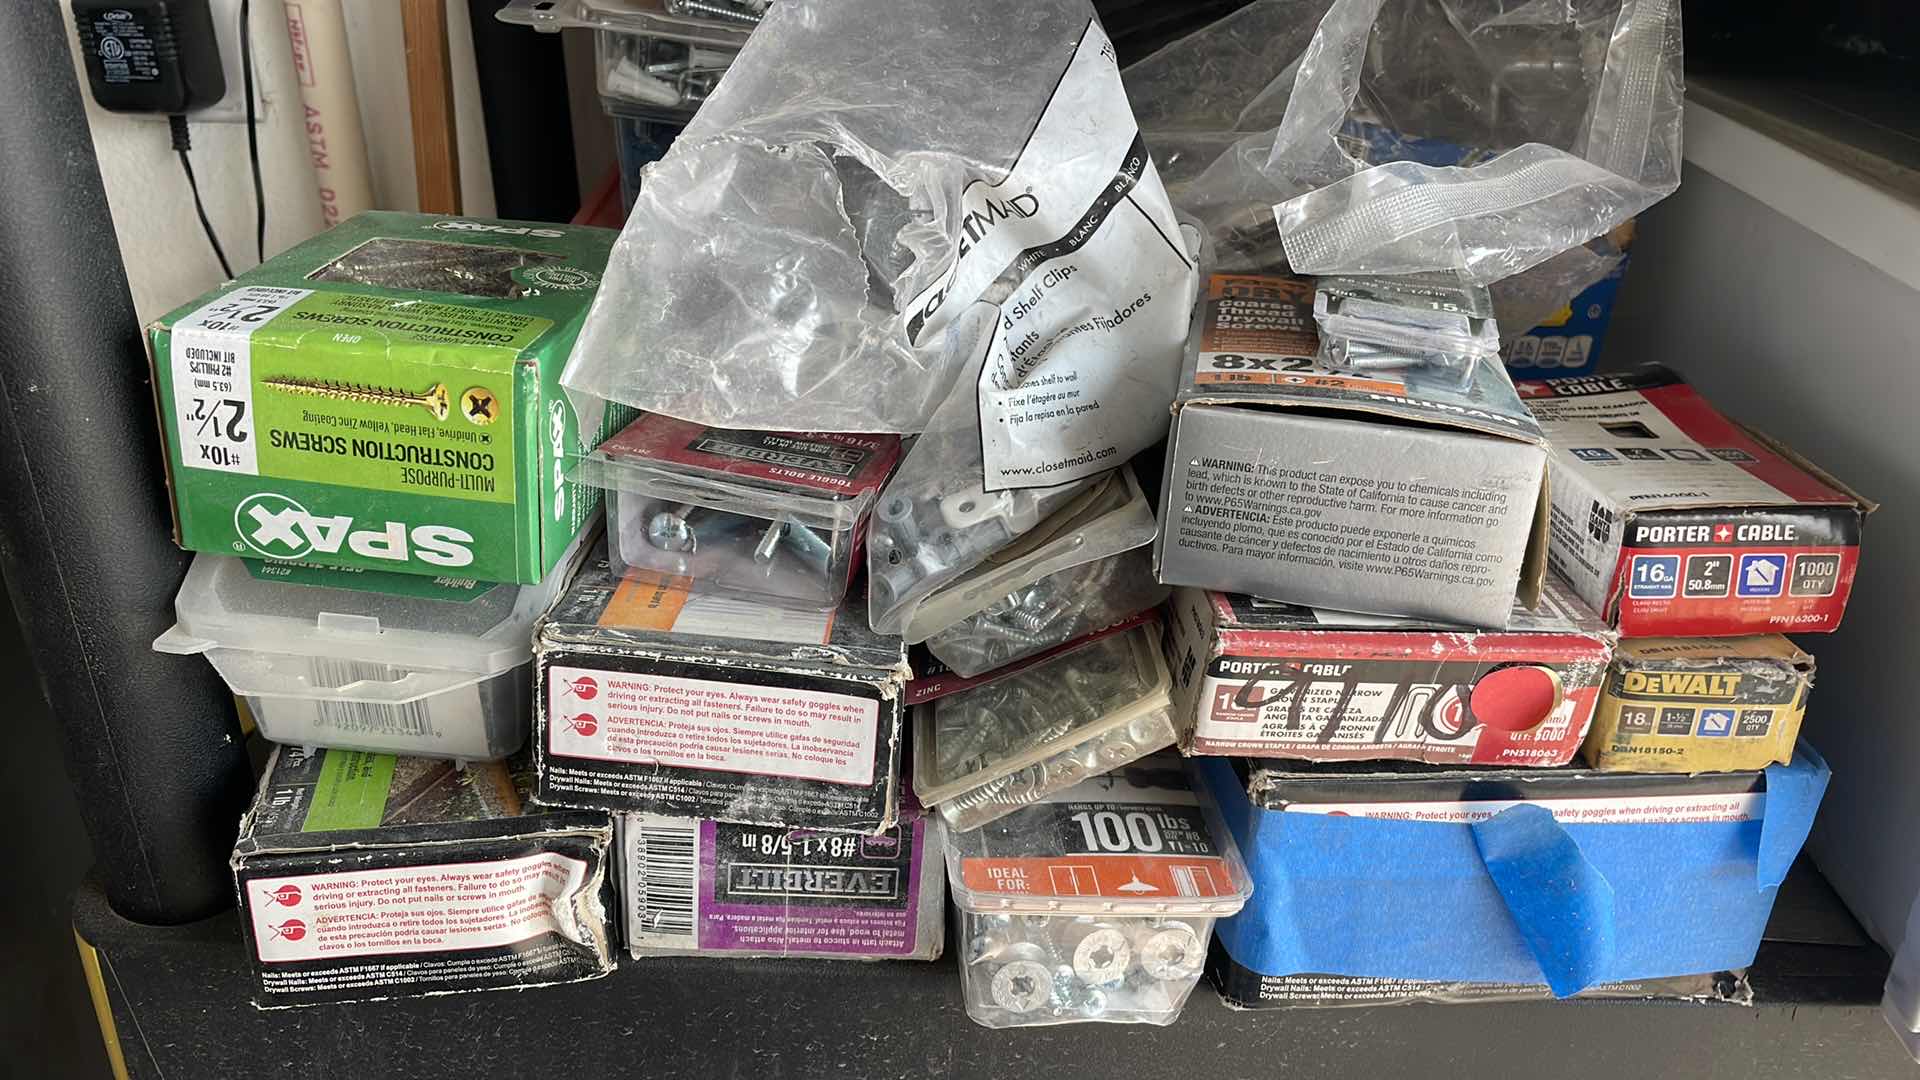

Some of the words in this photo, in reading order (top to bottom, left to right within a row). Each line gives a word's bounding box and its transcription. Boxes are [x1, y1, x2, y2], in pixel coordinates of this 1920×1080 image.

[304, 104, 330, 170] ASTM
[1018, 250, 1046, 272] WHITE
[1069, 216, 1098, 246] BLANC
[1114, 157, 1140, 193] BLANCO
[432, 222, 566, 238] SPAX
[1013, 284, 1043, 319] Shelf
[1043, 264, 1077, 288] Clips
[1093, 292, 1151, 332] Fijadores
[1217, 307, 1295, 317] Thread
[1219, 300, 1296, 309] Coarse
[1431, 303, 1457, 312] 15
[292, 311, 363, 327] SCREWS
[1217, 315, 1303, 325] Drywall
[368, 318, 514, 343] CONSTRUCTION
[1216, 323, 1300, 331] Screws
[332, 333, 361, 344] OPEN
[185, 346, 220, 361] INCLUDED
[222, 351, 234, 362] BIT
[189, 360, 220, 374] PHILLIPS
[221, 364, 230, 375] #2
[193, 378, 209, 389] mm)
[210, 379, 231, 391] (63.5
[1557, 379, 1627, 395] CABLE
[302, 410, 335, 425] Coating
[1025, 412, 1033, 421] la
[1035, 411, 1054, 423] repisa
[1066, 407, 1074, 415] la
[1076, 400, 1099, 414] pared
[338, 416, 357, 428] Zinc
[359, 418, 388, 431] Yellow
[391, 422, 414, 435] Head,
[416, 424, 435, 437] Flat
[437, 427, 476, 441] Unidrive,
[269, 428, 346, 454] SCREWS
[199, 444, 239, 466] #10x
[351, 438, 494, 470] CONSTRUCTION
[1000, 446, 1117, 476] www.closetmaid.com
[551, 403, 565, 521] SPAX
[400, 466, 495, 492] MULTI-PURPOSE
[768, 467, 805, 479] BOLTS
[809, 472, 852, 487] TOGGLE
[1202, 458, 1254, 472] WARNING:
[1257, 465, 1277, 475] This
[1279, 468, 1316, 481] product
[1319, 473, 1336, 482] can
[1339, 476, 1374, 489] expose
[1376, 480, 1394, 491] you
[1409, 483, 1459, 497] chemicals
[1461, 489, 1506, 504] including
[1187, 468, 1209, 480] lead,
[1213, 471, 1241, 483] which
[1254, 476, 1286, 489] known
[1301, 481, 1316, 492] the
[1318, 483, 1344, 496] State
[1359, 488, 1405, 503] California
[1419, 498, 1449, 509] cause
[1452, 501, 1486, 513] cancer
[1488, 504, 1507, 515] and
[1194, 504, 1270, 523] ADVERTENCIA:
[1196, 493, 1322, 519] www.P65Warnings.ca.gov
[243, 500, 475, 567] SPAX
[1636, 526, 1710, 542] PORTER
[1737, 525, 1795, 541] CABLE
[1800, 562, 1833, 577] 1000
[1689, 580, 1725, 590] 50.8mm
[1803, 580, 1824, 589] QTY
[1770, 614, 1828, 623] PFN16200-1
[1220, 662, 1280, 674] PORT
[607, 680, 651, 692] WARNING:
[654, 685, 683, 694] Protect
[685, 688, 703, 697] your
[706, 691, 726, 699] eyes.
[729, 692, 758, 703] Always
[760, 696, 779, 704] wear
[781, 697, 806, 707] safety
[808, 701, 840, 712] goggles
[843, 705, 864, 714] when
[916, 683, 940, 696] ZINC
[1625, 712, 1645, 725] 18
[1743, 715, 1768, 724] 2500
[549, 782, 572, 792] Drywall
[574, 784, 599, 793] Screws:
[1416, 810, 1449, 820] Protect
[1451, 811, 1469, 821] your
[1554, 809, 1580, 819] safety
[1582, 808, 1616, 818] goggles
[1619, 806, 1641, 815] when
[1643, 804, 1673, 815] driving
[1686, 803, 1726, 813] extracting
[1728, 802, 1740, 810] all
[1072, 812, 1162, 852] 100
[1157, 814, 1190, 829] lbs
[742, 833, 755, 850] in
[818, 838, 827, 851] x
[830, 836, 855, 856] #8
[638, 840, 646, 877] 38902
[311, 880, 358, 891] WARNING:
[361, 878, 392, 887] Protect
[394, 877, 414, 885] your
[416, 875, 438, 884] eyes.
[440, 872, 470, 883] Always
[472, 872, 492, 880] wear
[494, 868, 519, 878] safety
[735, 868, 890, 893] EVERBILT
[987, 867, 1028, 879] IDEAL
[997, 879, 1030, 890] FOR:
[638, 882, 646, 919] 05903
[315, 912, 378, 924] ADVERTENCIA:
[788, 936, 811, 944] metal.
[879, 938, 904, 946] Attach
[1261, 984, 1289, 993] Drywall
